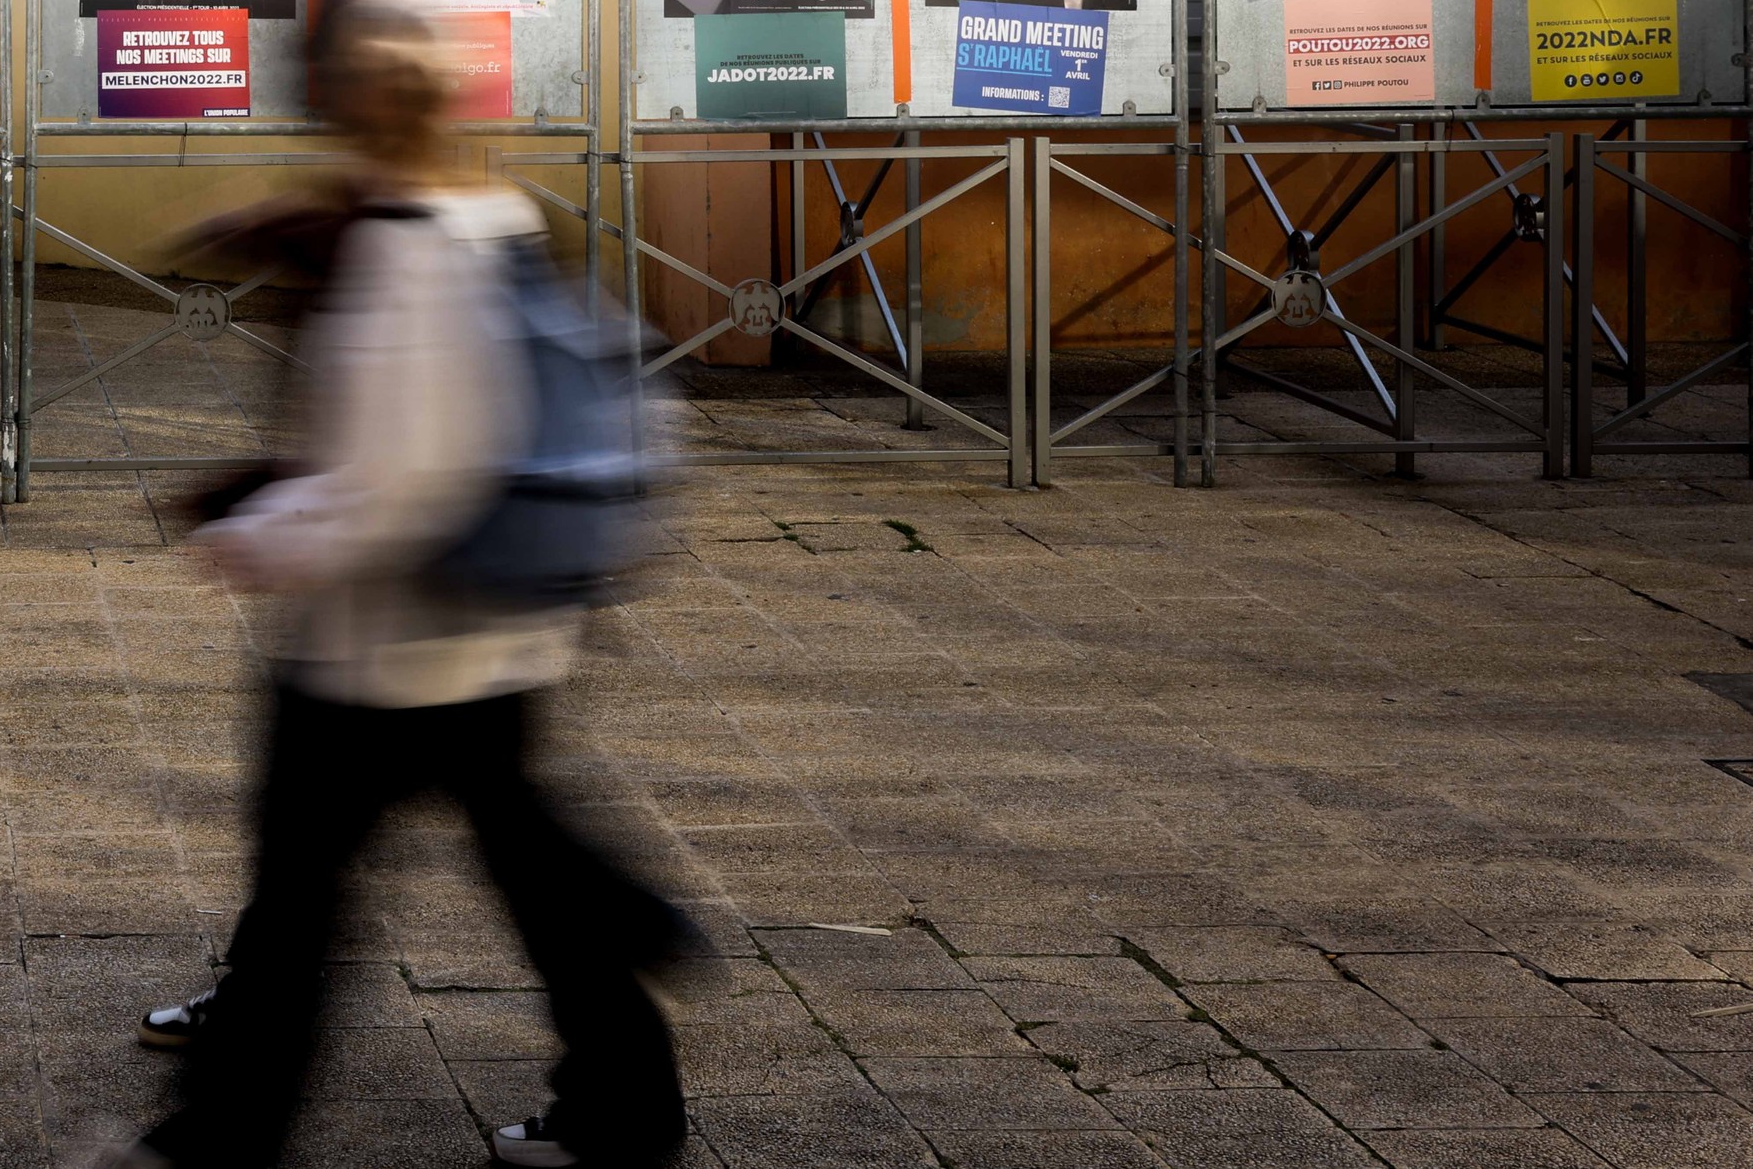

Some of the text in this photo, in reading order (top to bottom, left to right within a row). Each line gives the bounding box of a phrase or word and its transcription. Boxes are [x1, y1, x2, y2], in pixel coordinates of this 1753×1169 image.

[123, 31, 224, 47] RETROUVEZ TOUS
[961, 16, 1104, 49] GRAND MEETING
[1537, 28, 1672, 50] 2022NDA.FR
[1289, 36, 1429, 53] POUTOU2022.ORG
[116, 48, 231, 65] NOS MEETINGS SUR
[974, 44, 1052, 72] RAPHAËL
[1060, 50, 1098, 59] VENDREDI
[1293, 55, 1426, 67] ET SUR LES RÉSEAUX SOCIAUX
[105, 73, 243, 86] MELENCHON2022.FR
[707, 67, 835, 83] JADOT2022.FR
[1066, 71, 1090, 80] AVRIL
[1378, 79, 1409, 87] POUTOU
[982, 86, 1040, 101] INFORMATIONS
